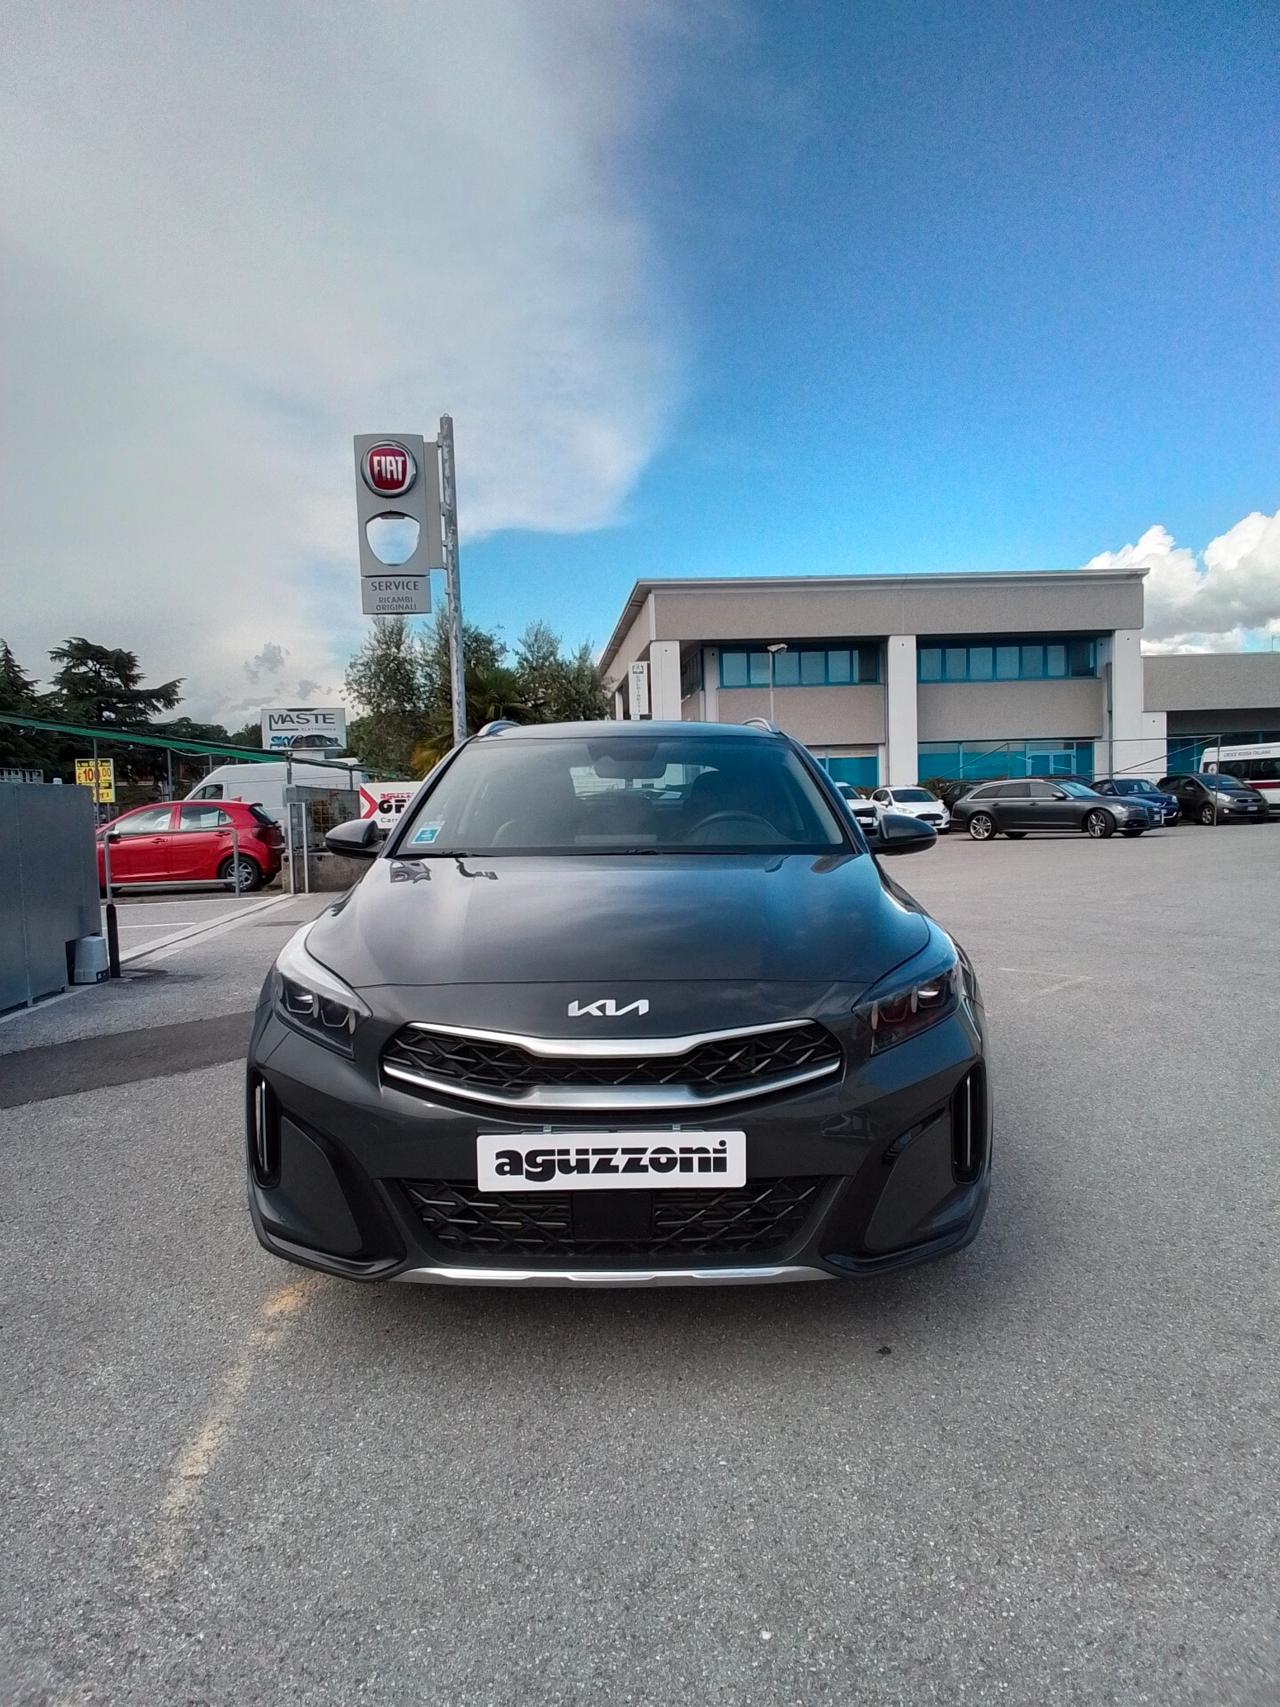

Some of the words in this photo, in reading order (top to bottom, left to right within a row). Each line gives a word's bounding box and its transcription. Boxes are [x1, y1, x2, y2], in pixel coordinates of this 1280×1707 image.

[373, 455, 405, 481] FIAT
[371, 580, 420, 591] SERVICE
[378, 596, 413, 604] RICAMBI
[269, 713, 336, 725] MASTE
[379, 799, 410, 814] GF
[567, 999, 650, 1017] KIA
[495, 1139, 728, 1183] aguzzoni
